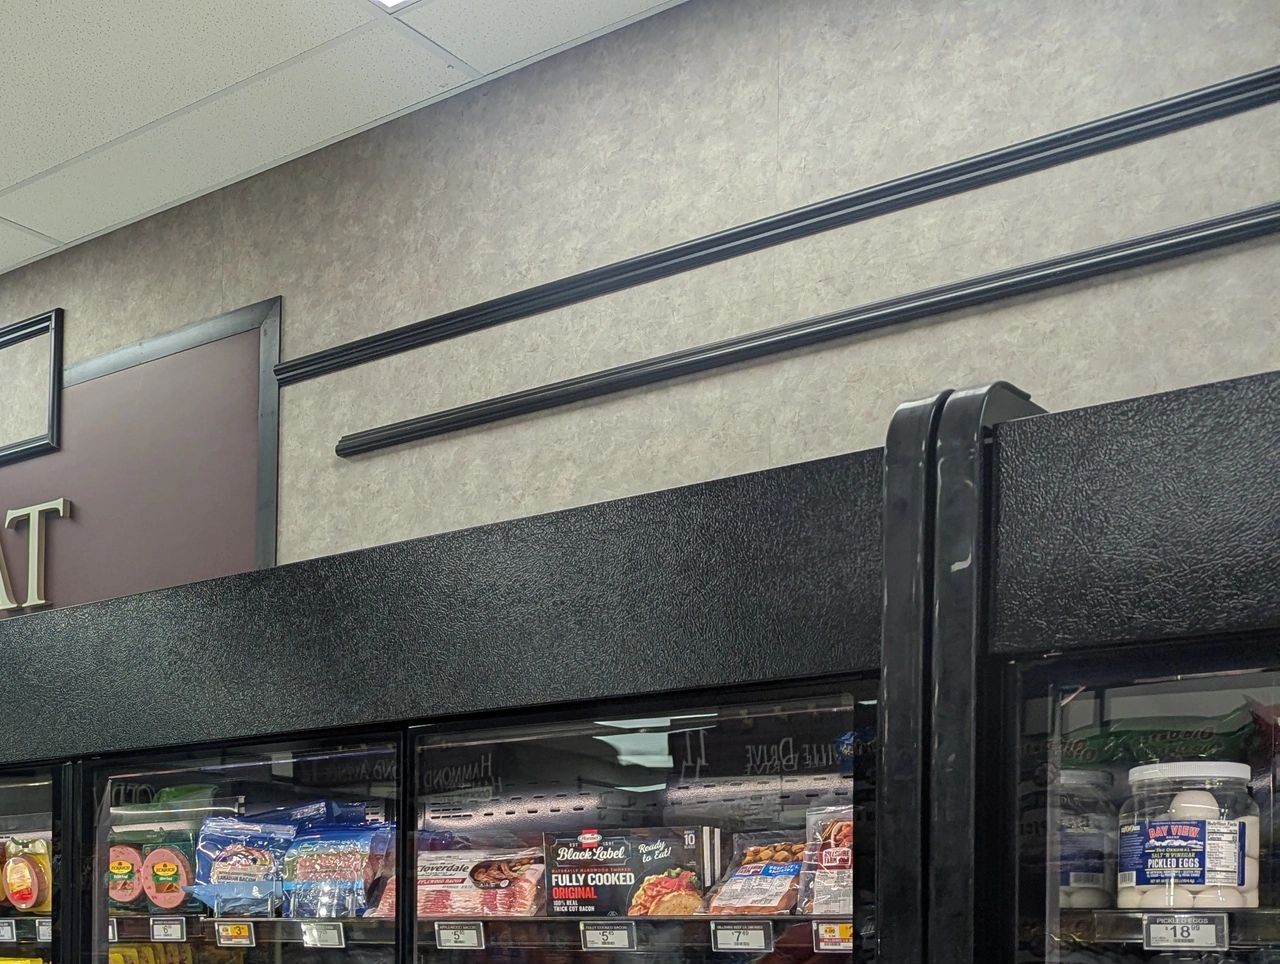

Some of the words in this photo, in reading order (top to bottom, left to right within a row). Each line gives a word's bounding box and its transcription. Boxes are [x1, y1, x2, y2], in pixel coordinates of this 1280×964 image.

[1148, 824, 1168, 839] BAY
[1170, 824, 1200, 838] VIEW
[684, 834, 696, 845] 10
[638, 840, 666, 853] Ready
[557, 846, 593, 861] Black
[593, 847, 625, 860] Label
[643, 854, 651, 863] to
[654, 847, 672, 860] Eat!
[1148, 858, 1176, 868] PICKLED
[1179, 858, 1200, 868] EGGS
[551, 874, 586, 886] FULLY
[588, 873, 635, 886] COOKED
[553, 887, 597, 899] ORIGINAL
